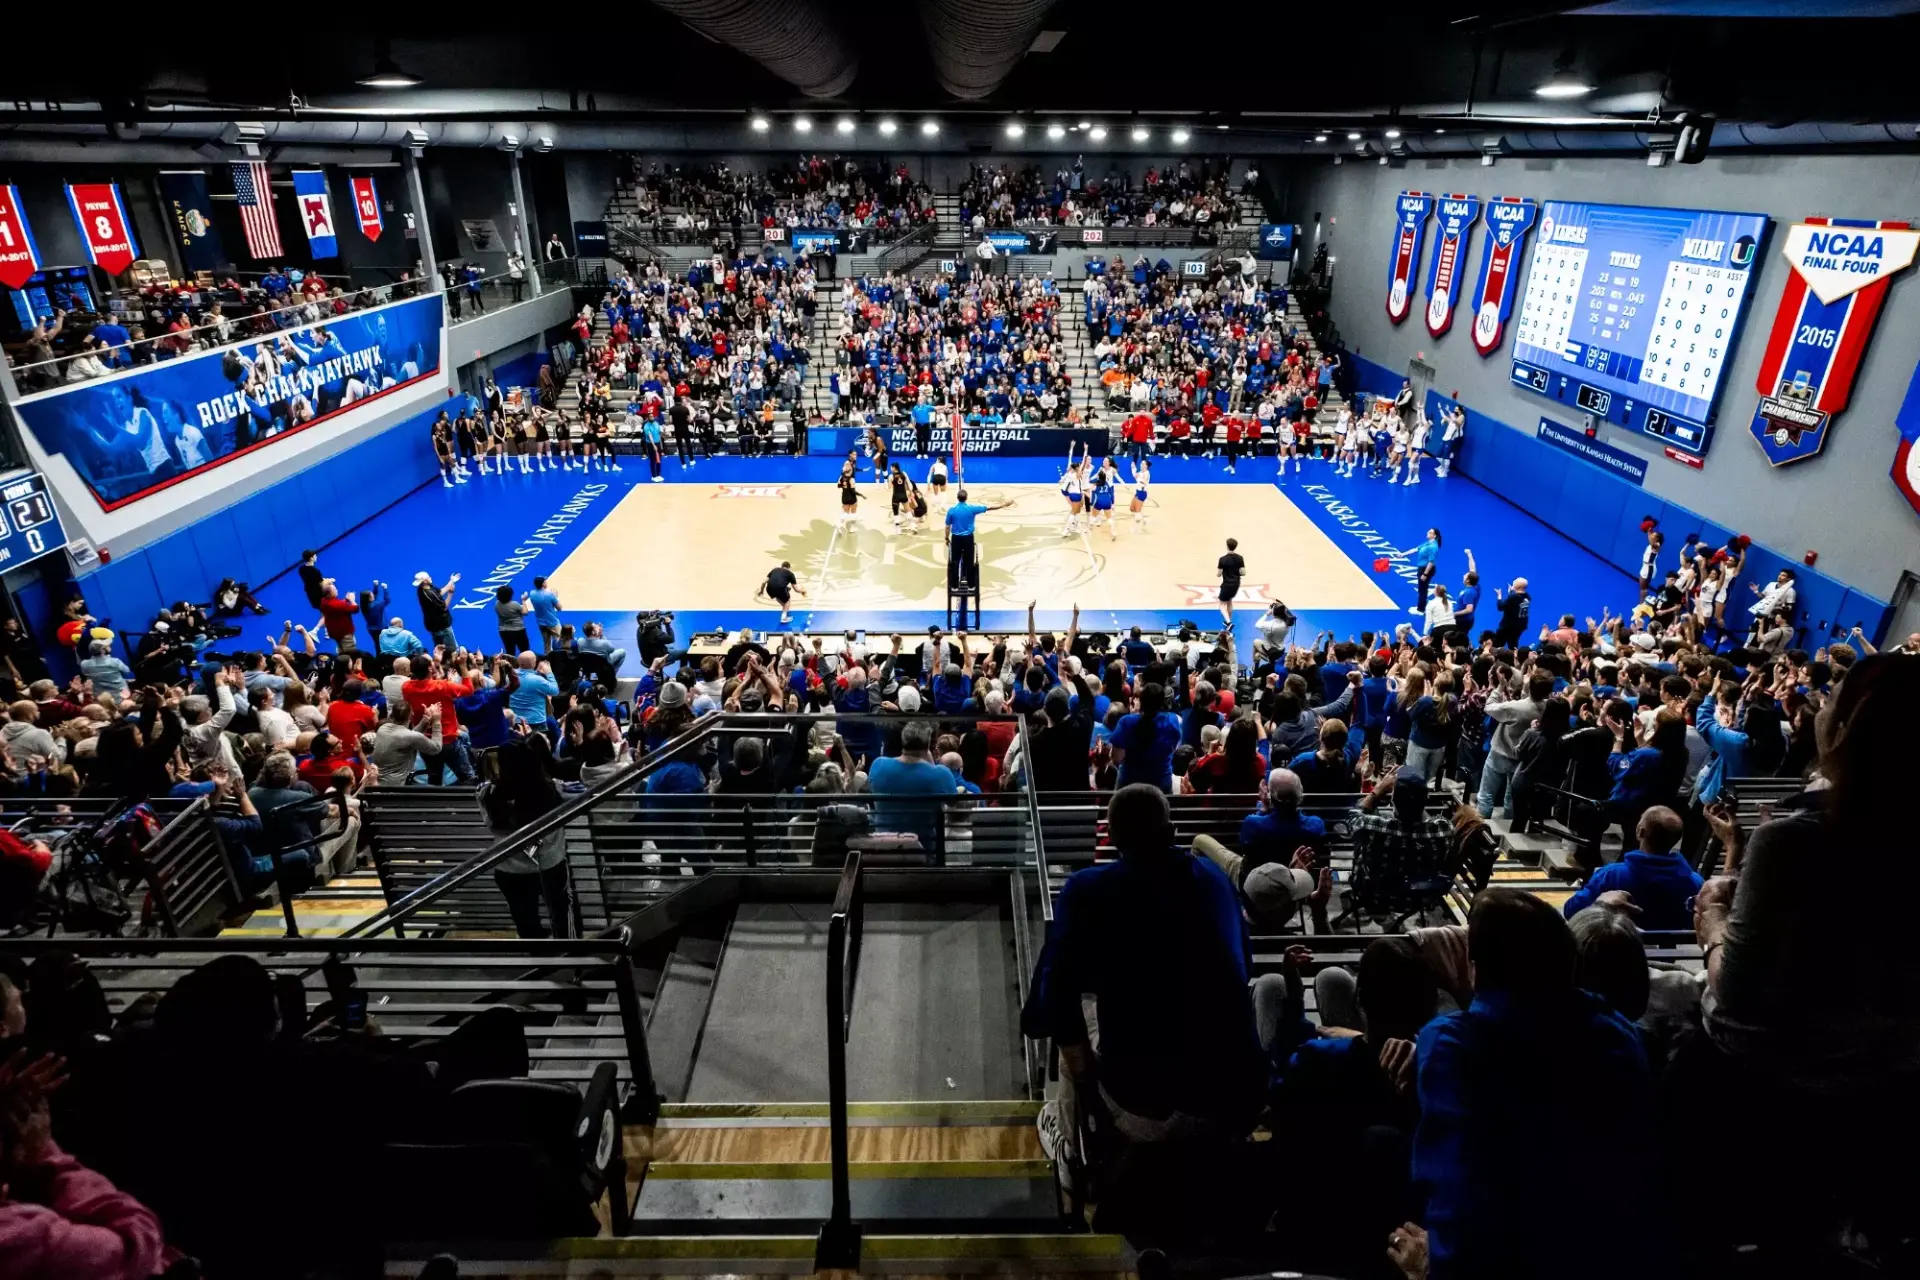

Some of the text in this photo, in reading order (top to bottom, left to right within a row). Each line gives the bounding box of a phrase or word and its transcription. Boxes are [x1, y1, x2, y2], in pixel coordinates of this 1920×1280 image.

[361, 200, 374, 216] 10
[1402, 199, 1423, 211] NCAA
[1443, 202, 1469, 216] NCAA
[1493, 205, 1525, 221] NCAA
[95, 216, 113, 239] 8
[766, 230, 783, 240] 201
[1084, 231, 1102, 240] 202
[1498, 231, 1511, 243] 16
[1680, 238, 1726, 262] MIAMI
[1806, 232, 1884, 259] NCAA
[1187, 264, 1203, 273] 103
[1802, 255, 1880, 275] FINAL FOUR
[1630, 276, 1639, 288] 19
[1727, 272, 1744, 282] ASST
[1705, 283, 1713, 294] 0
[1727, 287, 1735, 298] 0
[1431, 299, 1446, 318] KU
[1622, 306, 1636, 317] 2.0
[1664, 297, 1728, 318] 2 0 3 0
[1479, 313, 1496, 334] KU
[1618, 319, 1630, 330] 24
[1660, 316, 1722, 338] 5 0 0 0
[1654, 334, 1718, 359] 6 2 5 15
[1798, 325, 1836, 348] 2015
[1644, 367, 1653, 378] 12
[1648, 352, 1658, 362] 10
[1683, 362, 1690, 372] 0
[1704, 367, 1711, 378] 0
[196, 345, 383, 428] ROCK CHALK JAYHAWK
[1532, 371, 1546, 388] 24
[1587, 392, 1608, 412] 1:30
[1649, 413, 1667, 434] 21
[1762, 402, 1819, 426] CHAMPIONSHIP
[892, 430, 917, 440] NCA
[931, 430, 948, 440] DI
[15, 497, 48, 526] 21
[1301, 484, 1370, 527] KANSAS
[26, 529, 45, 554] 0
[452, 483, 608, 610] KANSAS JAYHAWKS
